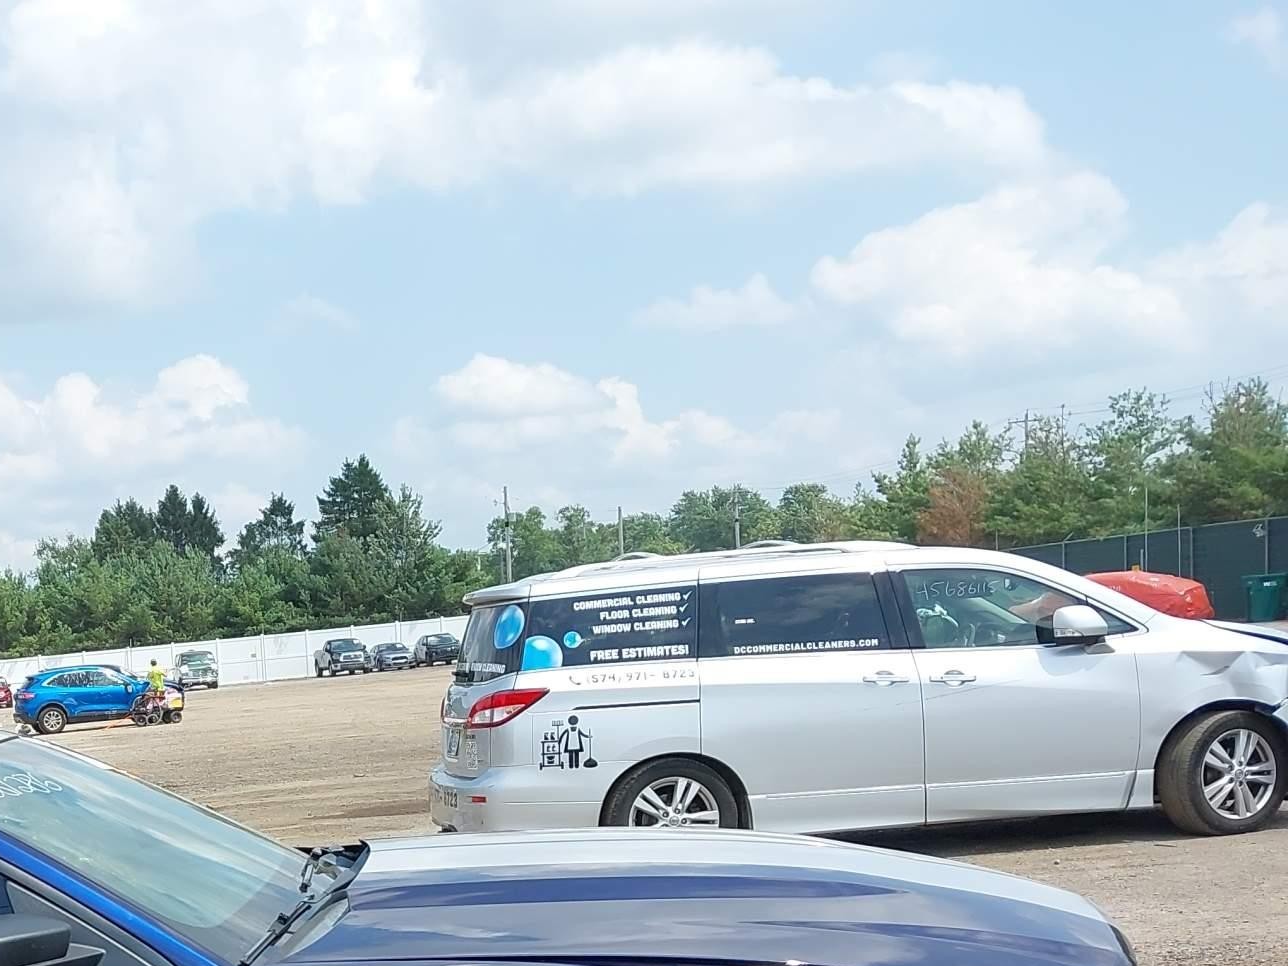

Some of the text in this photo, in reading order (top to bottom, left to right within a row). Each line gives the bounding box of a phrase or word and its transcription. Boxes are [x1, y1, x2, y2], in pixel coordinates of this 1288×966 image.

[573, 592, 681, 611] COMMERCIAL CLEANING
[600, 605, 678, 621] FLOOR CLEANING
[592, 619, 679, 635] WINDOW CLEANING
[590, 644, 689, 662] FREE ESTIMATES!
[733, 638, 878, 655] DCCOMMERCIALCLEANERS.COM
